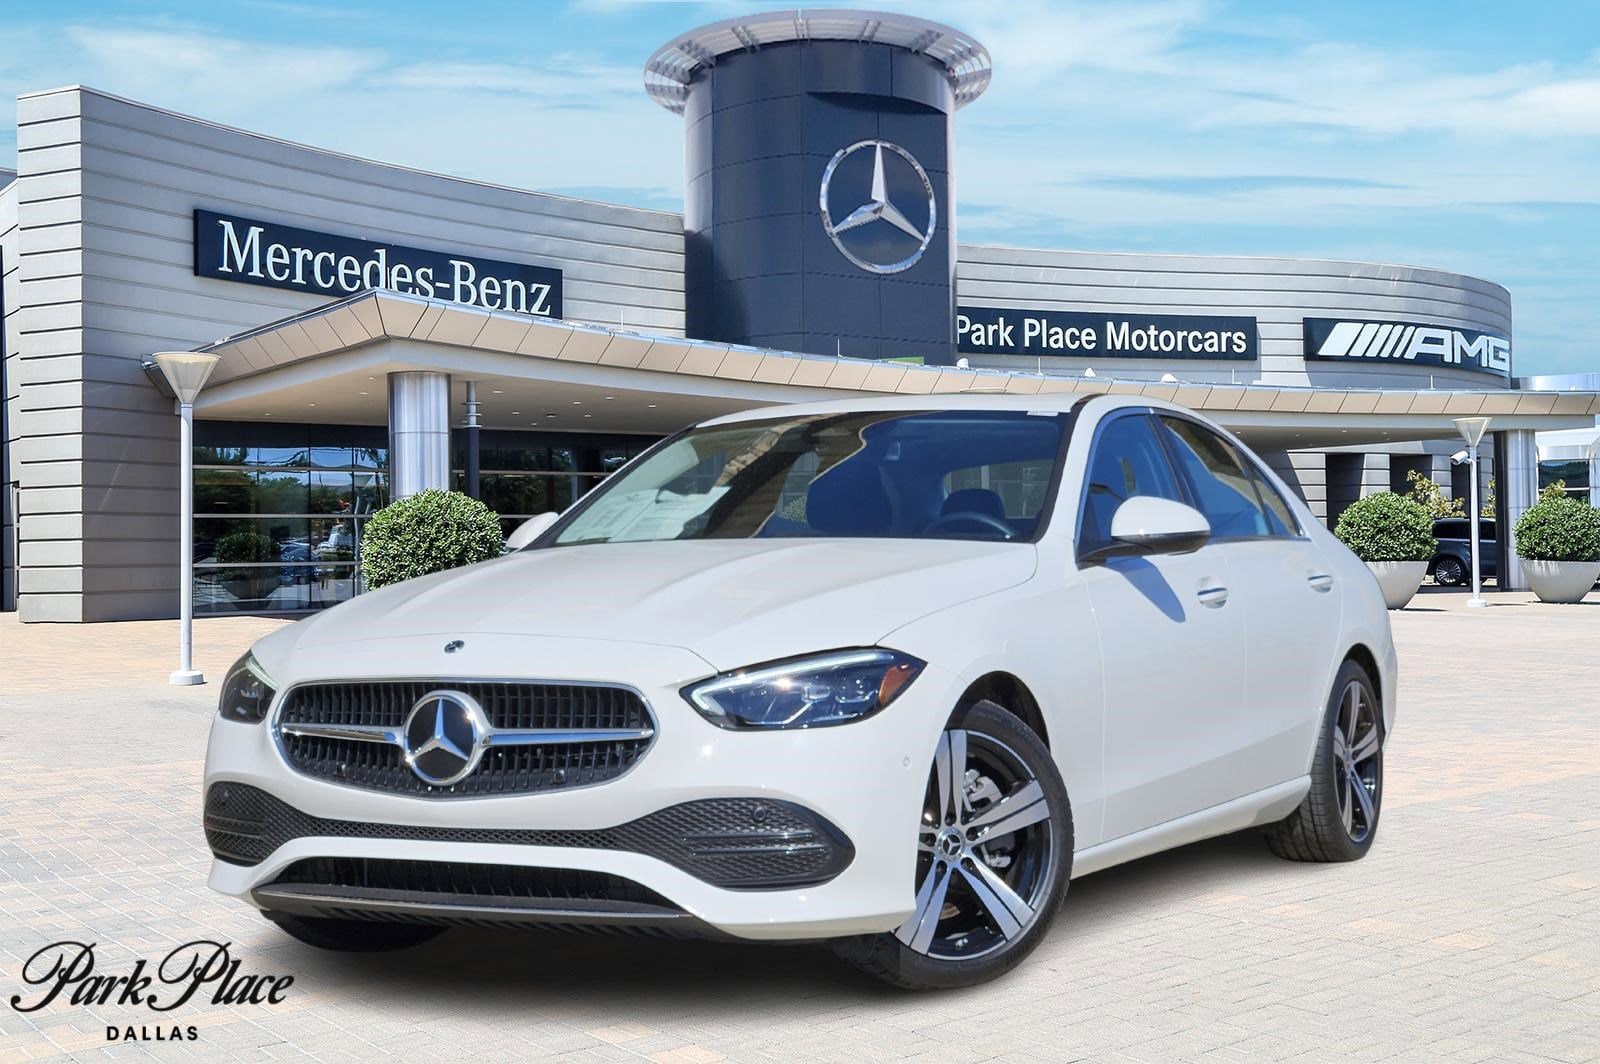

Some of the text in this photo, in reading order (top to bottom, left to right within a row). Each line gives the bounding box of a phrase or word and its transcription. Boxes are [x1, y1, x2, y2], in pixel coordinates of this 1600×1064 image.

[217, 219, 552, 316] Mercedes-Benz
[956, 314, 1248, 357] Park Place Motorcars
[1403, 327, 1510, 372] AMG
